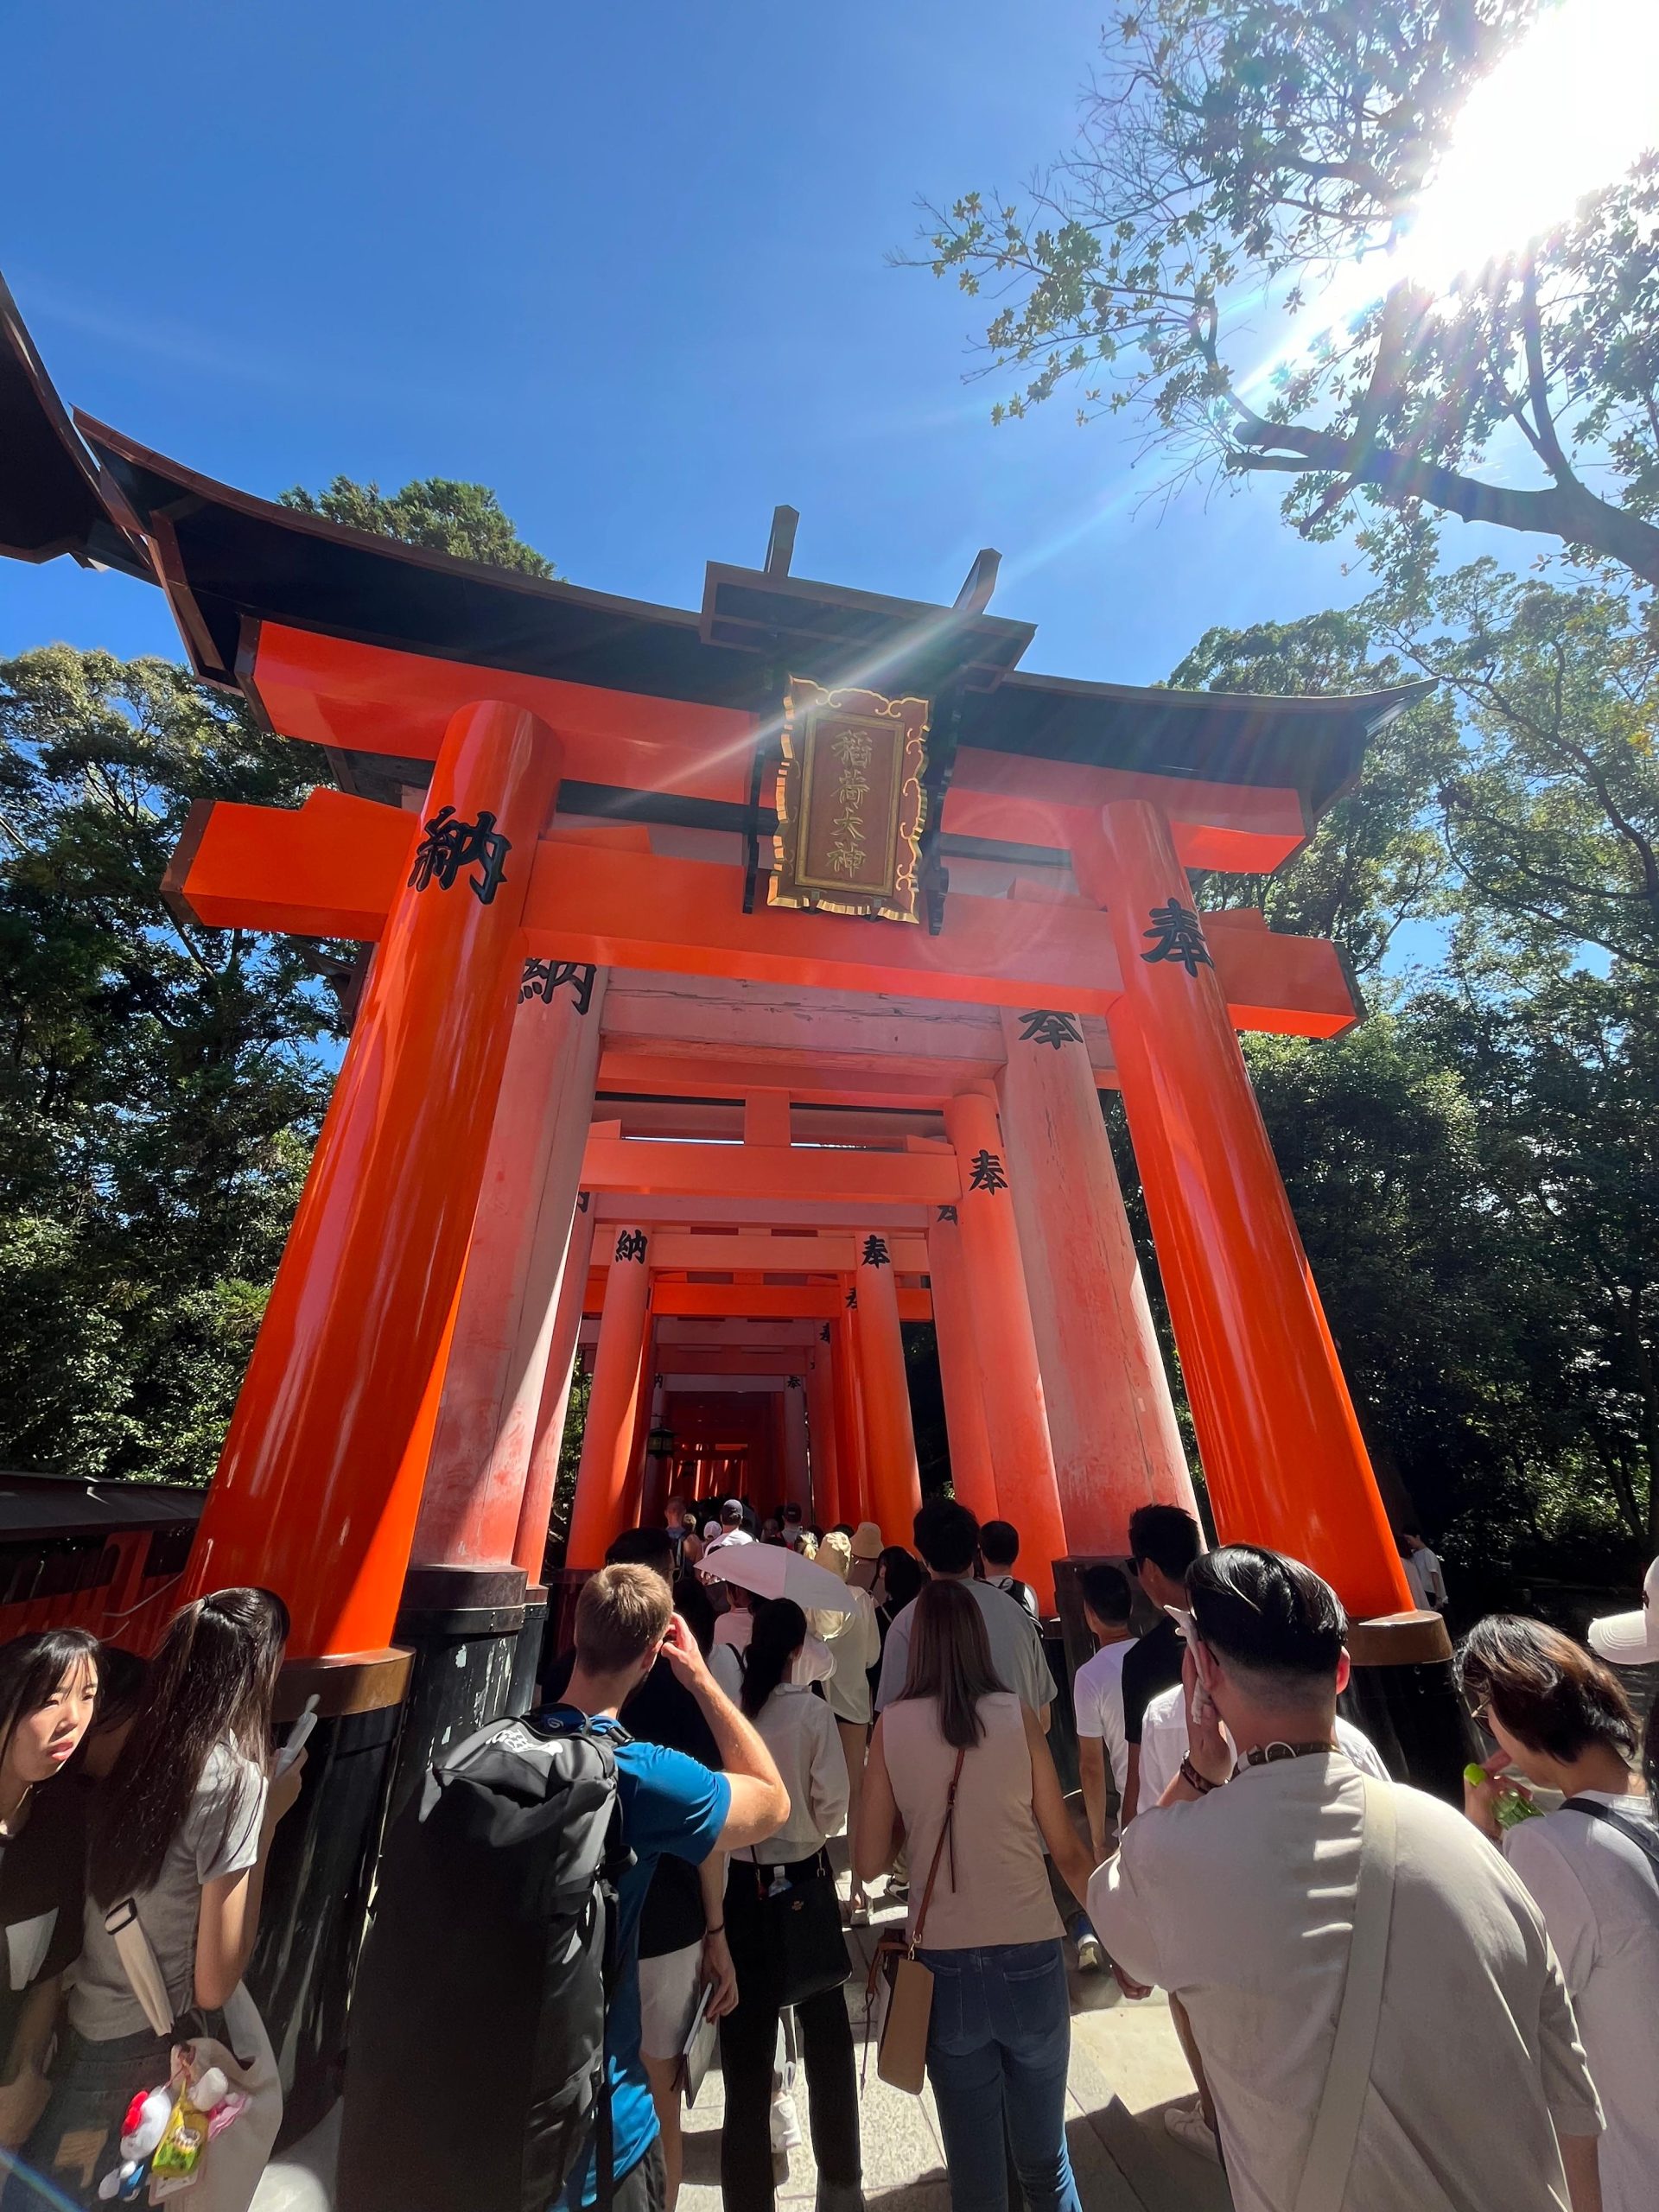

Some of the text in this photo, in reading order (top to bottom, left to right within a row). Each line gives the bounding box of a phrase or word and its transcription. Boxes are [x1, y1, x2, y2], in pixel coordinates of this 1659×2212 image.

[407, 805, 512, 905] 納
[1140, 897, 1216, 978] 奉
[969, 1149, 1008, 1196] 奉
[615, 1229, 648, 1264] 納
[861, 1234, 891, 1269] 奉
